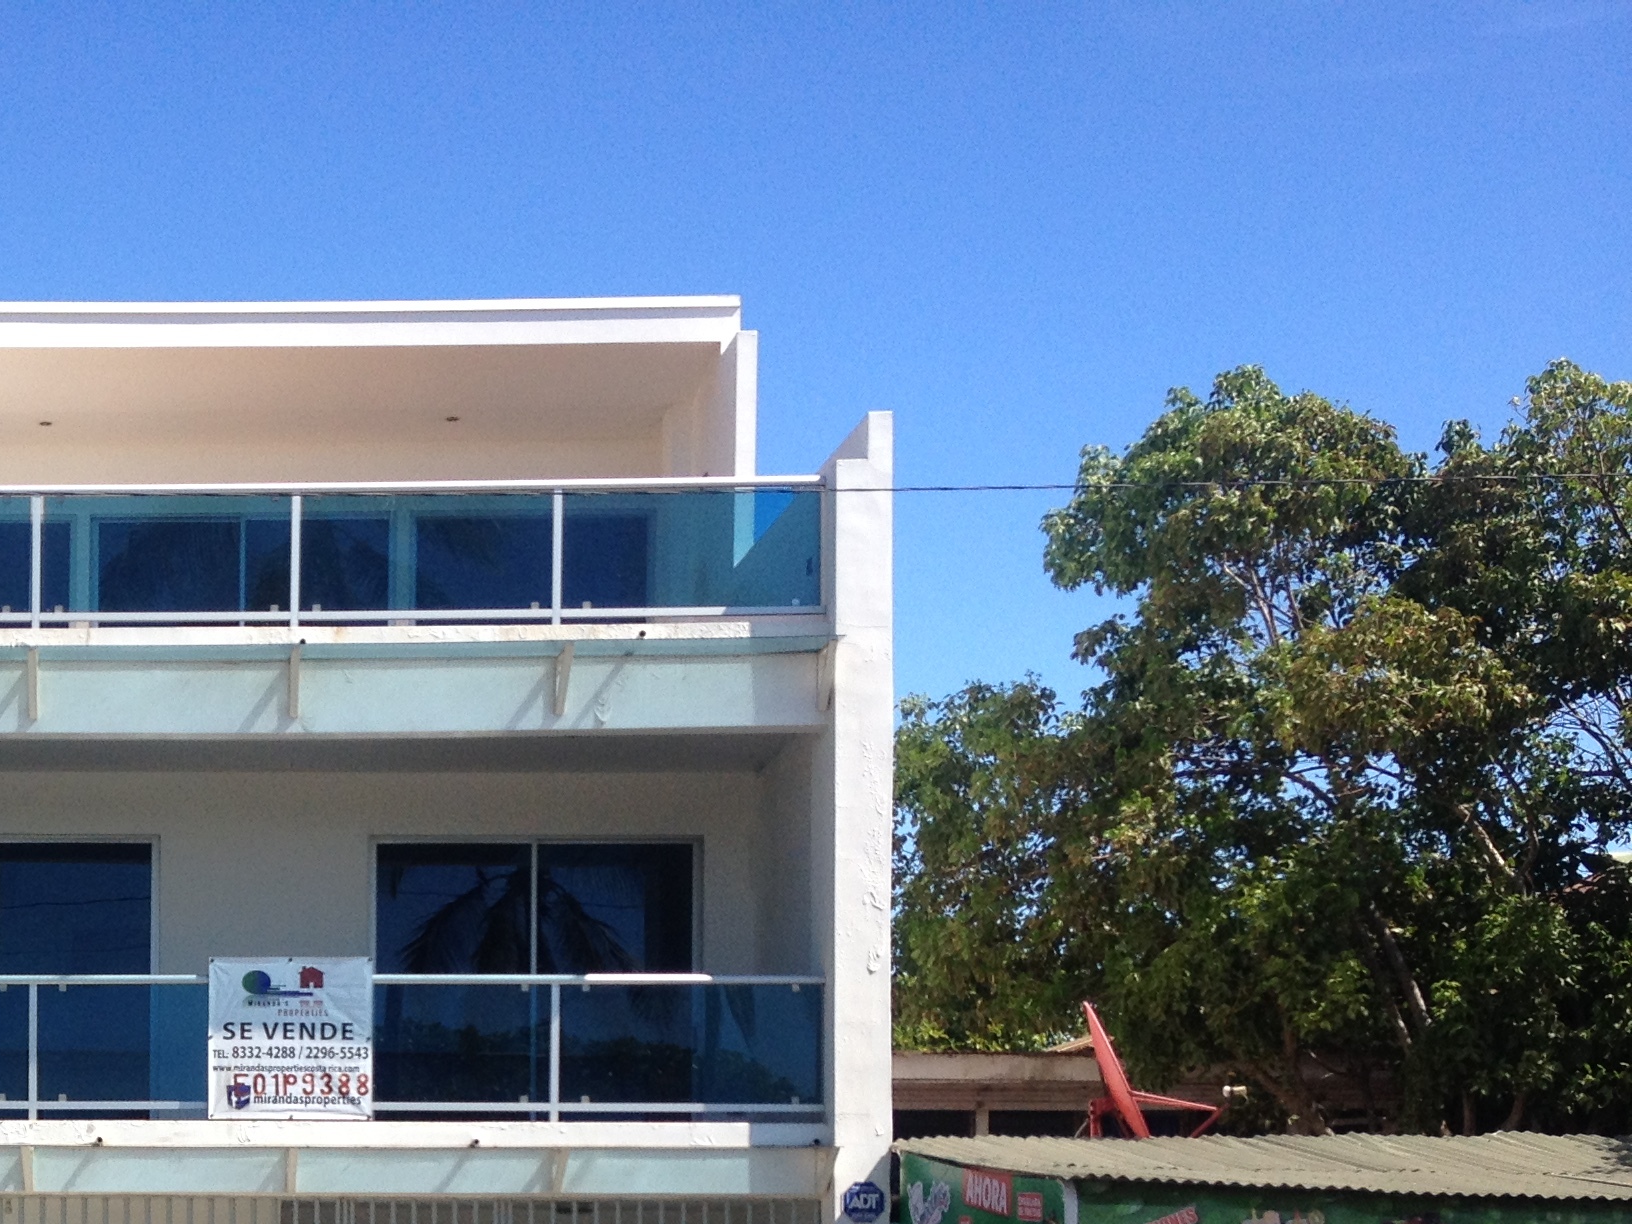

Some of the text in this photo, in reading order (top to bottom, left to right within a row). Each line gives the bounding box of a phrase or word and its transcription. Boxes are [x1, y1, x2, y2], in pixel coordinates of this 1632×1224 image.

[222, 1022, 354, 1041] SE VENDE
[213, 1049, 229, 1059] TEL:
[231, 1046, 296, 1059] 8332-4288
[305, 1046, 369, 1060] 2296-5543
[848, 1193, 879, 1209] ADT
[966, 1173, 1008, 1215] AHORA
